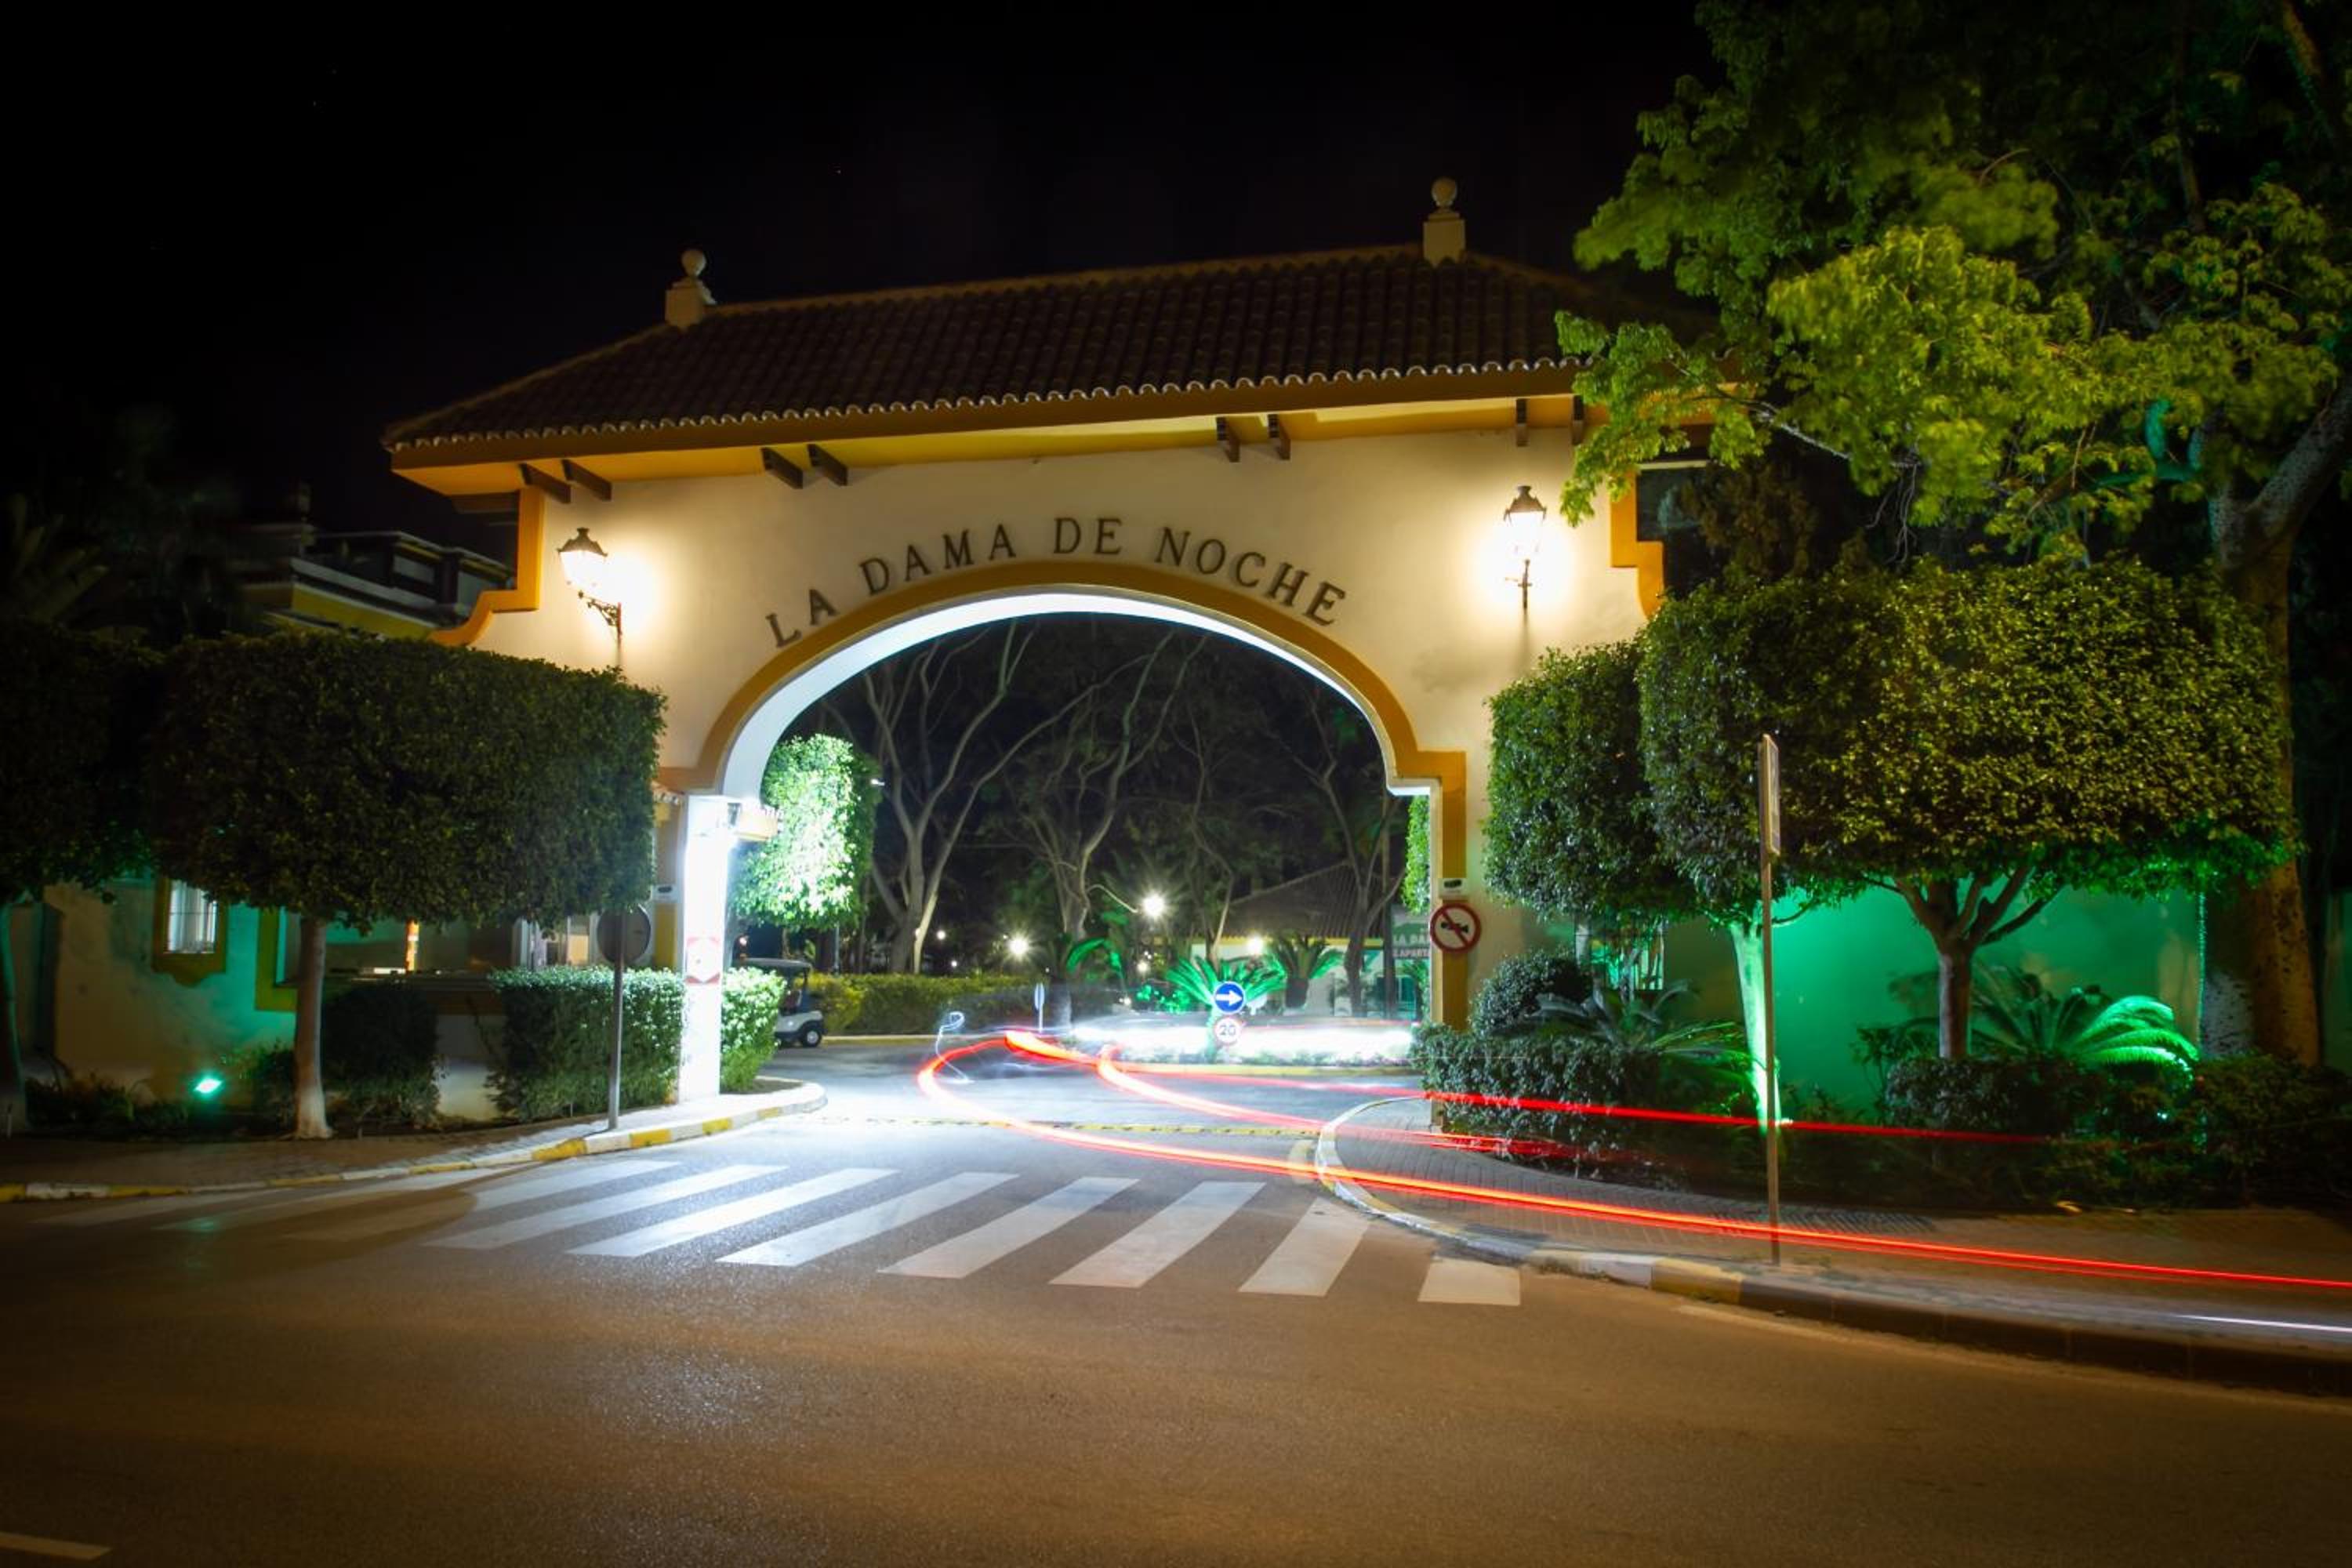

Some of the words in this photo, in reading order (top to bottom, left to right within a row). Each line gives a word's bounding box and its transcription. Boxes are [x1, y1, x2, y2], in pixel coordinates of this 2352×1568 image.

[766, 589, 839, 648] LA
[858, 523, 1017, 597] DAMA
[1054, 517, 1123, 556] DE
[1153, 526, 1346, 626] NOCHE
[1219, 1023, 1236, 1036] 20
